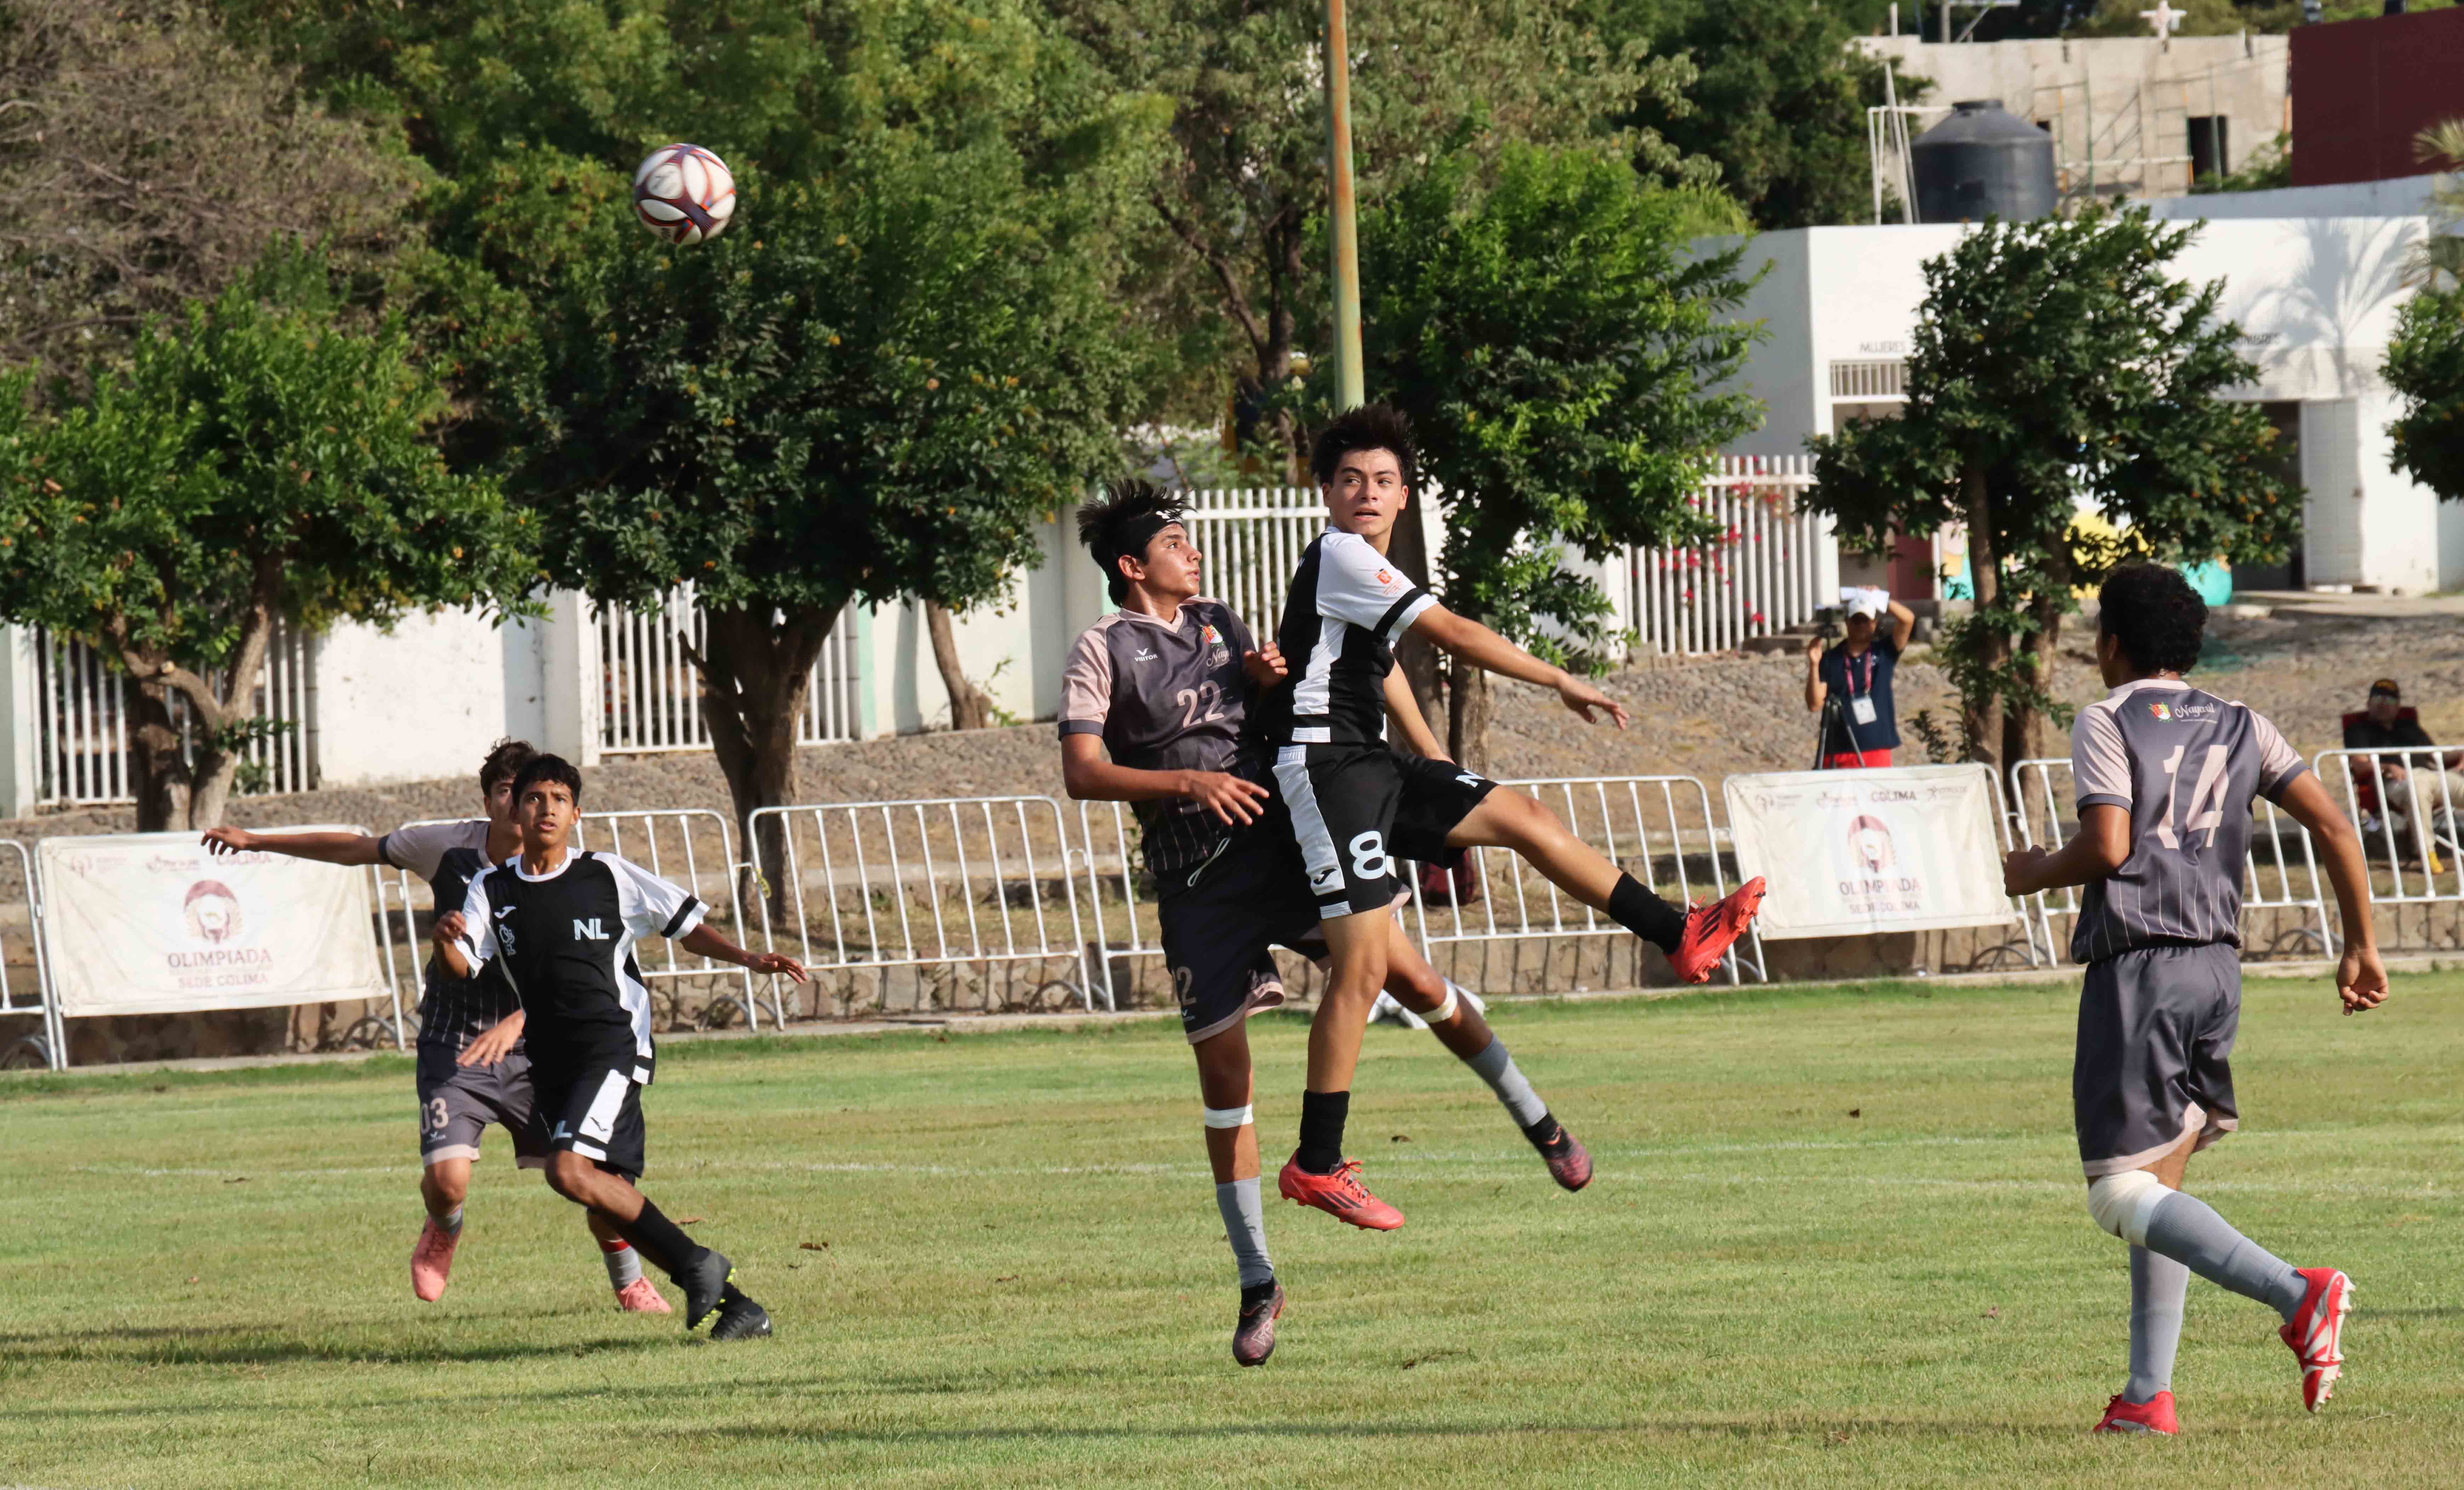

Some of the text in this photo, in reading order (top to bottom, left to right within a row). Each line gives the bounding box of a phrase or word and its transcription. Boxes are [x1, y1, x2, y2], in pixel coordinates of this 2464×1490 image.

[1860, 340, 1905, 352] MUJERES
[1135, 654, 1158, 662] VISITOR
[1177, 680, 1225, 729] 22
[2175, 702, 2215, 718] Nayarit
[1871, 790, 1917, 801] COLIMA
[2157, 745, 2229, 850] 14
[1349, 831, 1386, 879] 8
[573, 919, 609, 940] NL
[167, 949, 272, 968] OLIMPIADA
[178, 973, 268, 989] SEDE COLIMA
